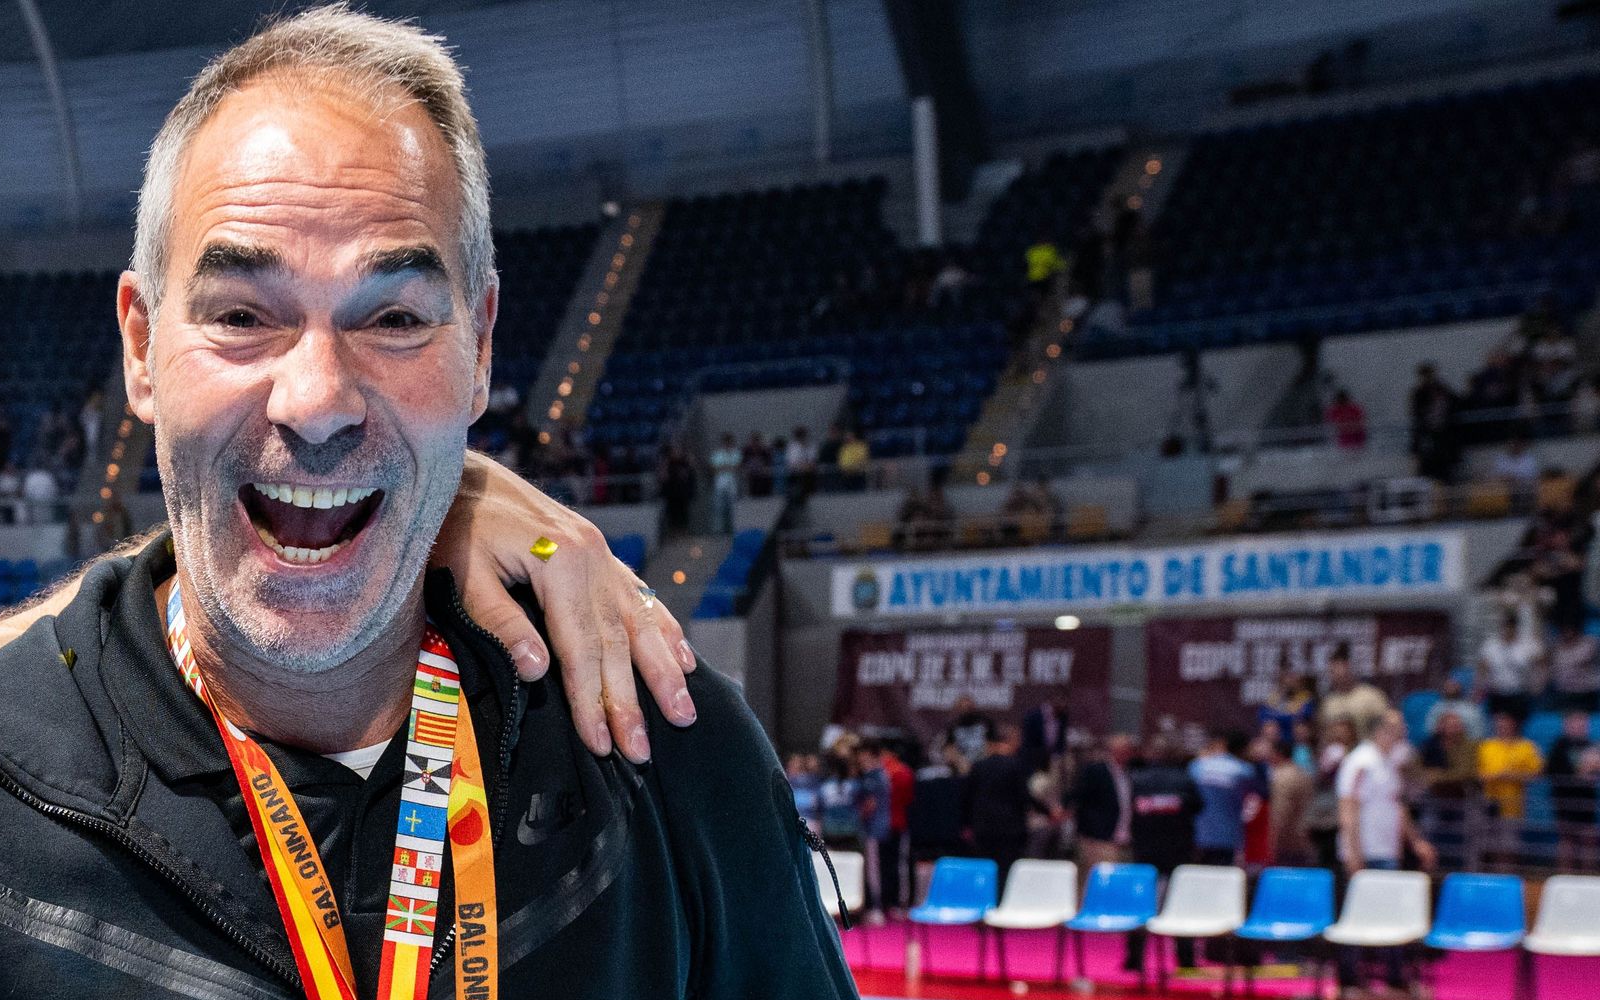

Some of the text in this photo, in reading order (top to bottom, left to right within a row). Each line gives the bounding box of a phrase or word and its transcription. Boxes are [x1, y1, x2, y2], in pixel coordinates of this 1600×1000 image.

[888, 543, 1443, 607] AYUNTAMIENTO DE SANTANDER
[252, 772, 340, 930] BALONMANO
